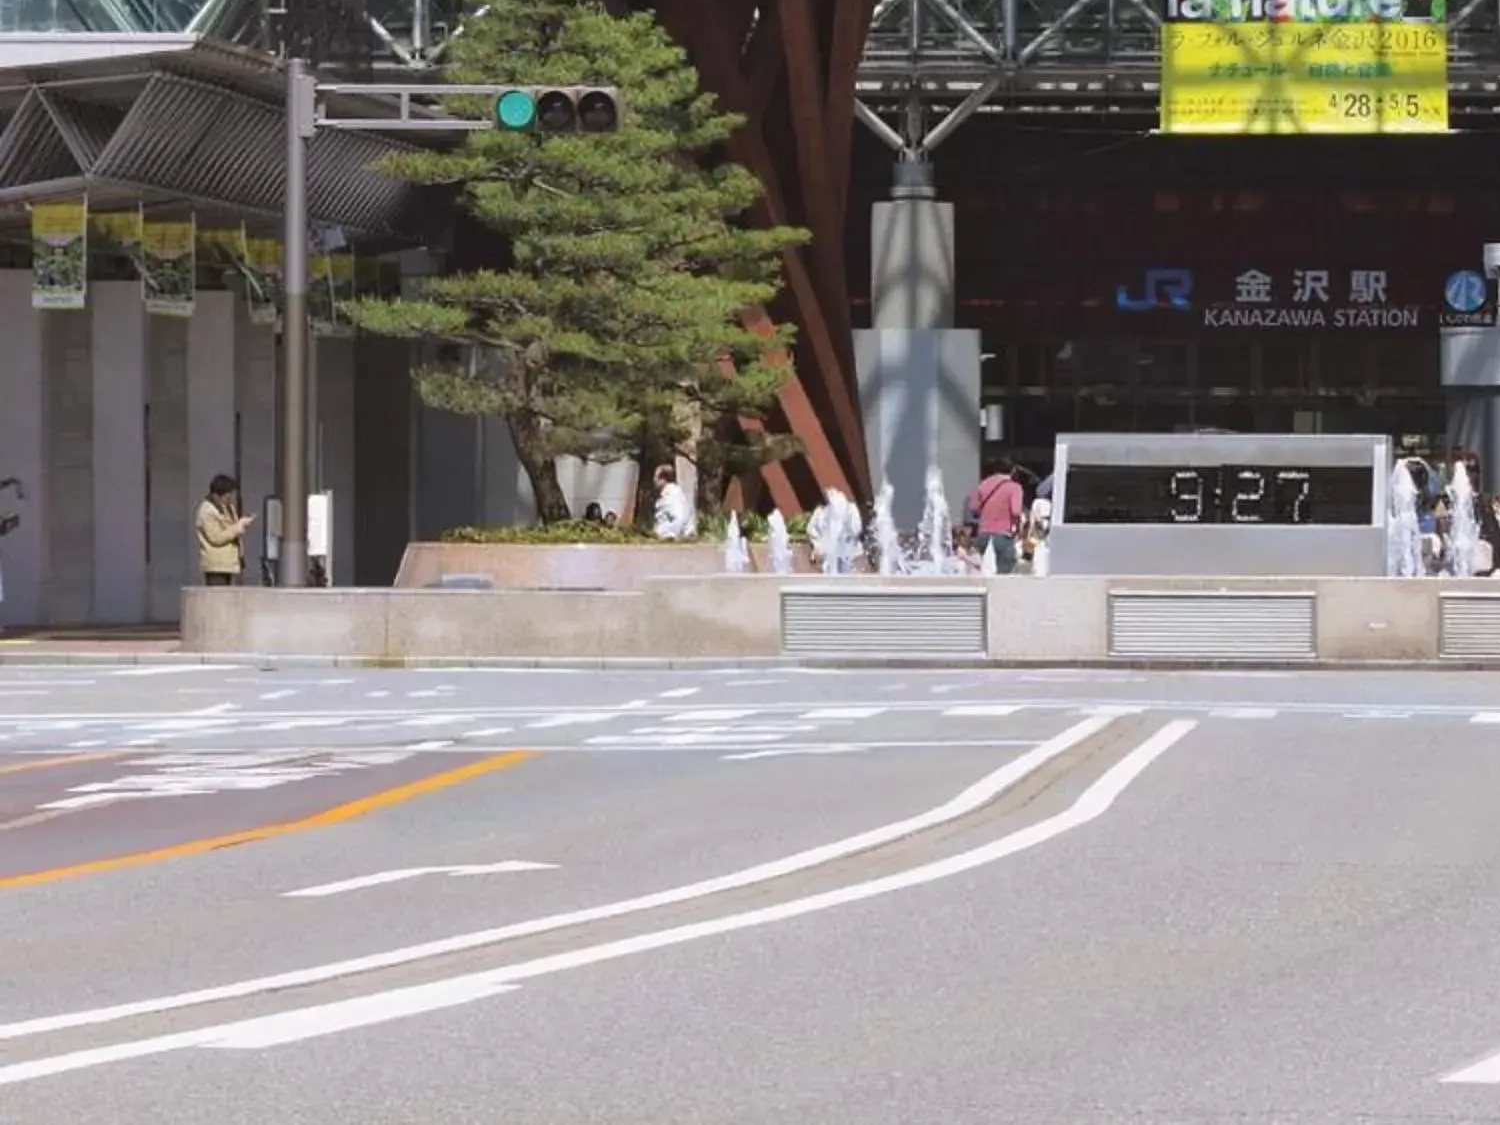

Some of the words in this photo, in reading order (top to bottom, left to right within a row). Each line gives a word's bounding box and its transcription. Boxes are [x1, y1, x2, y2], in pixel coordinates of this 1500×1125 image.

[1117, 267, 1194, 311] JR
[1204, 309, 1325, 328] KANAZAWA
[1334, 308, 1419, 328] STATION
[1171, 470, 1310, 522] 9:27
